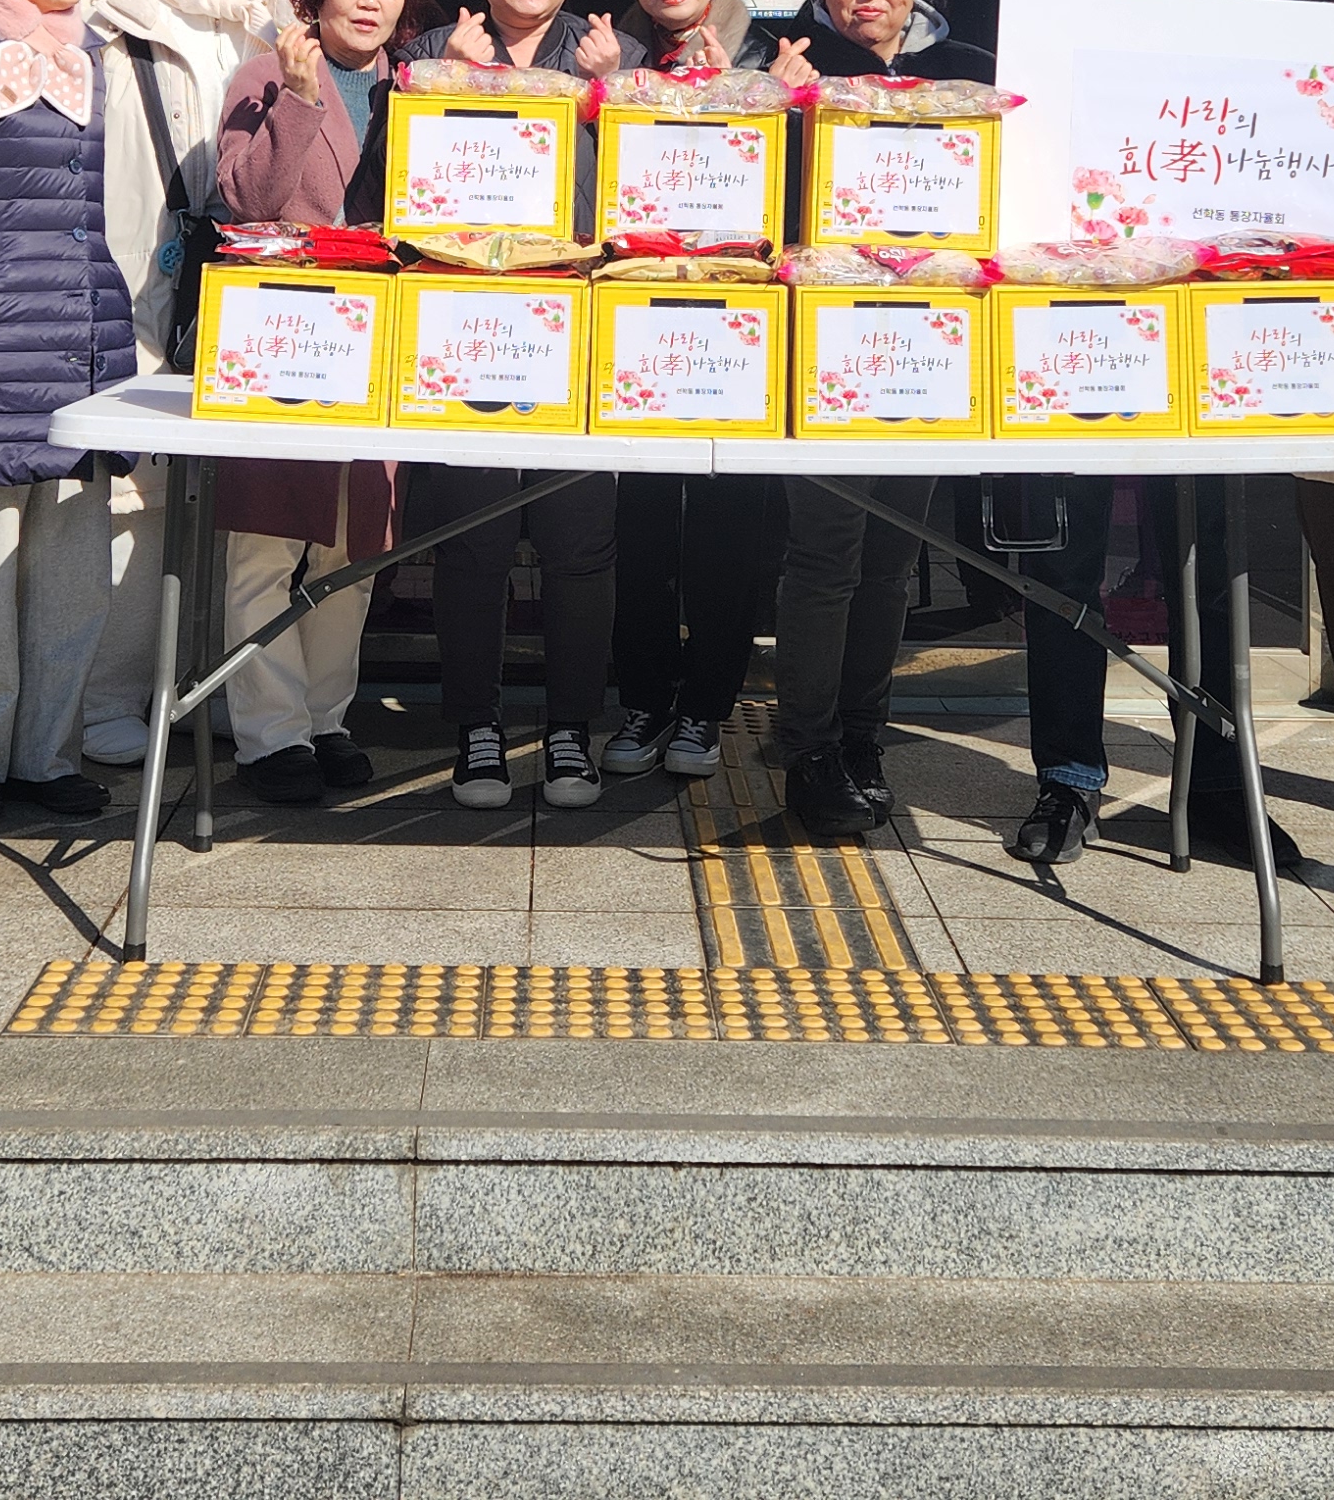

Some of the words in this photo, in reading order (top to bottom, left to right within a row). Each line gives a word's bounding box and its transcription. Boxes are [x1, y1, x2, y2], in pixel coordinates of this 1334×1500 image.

[1159, 96, 1257, 138] 사랑의
[452, 140, 501, 160] 사랑의
[661, 148, 710, 168] 사랑의
[875, 151, 925, 171] 사랑의
[1192, 207, 1226, 222] 선학동
[1229, 210, 1286, 225] 통장자율회
[265, 313, 316, 335] 사랑의
[462, 317, 513, 338] 사랑의
[659, 331, 709, 352] 사랑의
[861, 331, 912, 352] 사랑의
[1058, 329, 1108, 349] 사랑의
[1251, 326, 1302, 347] 사랑의
